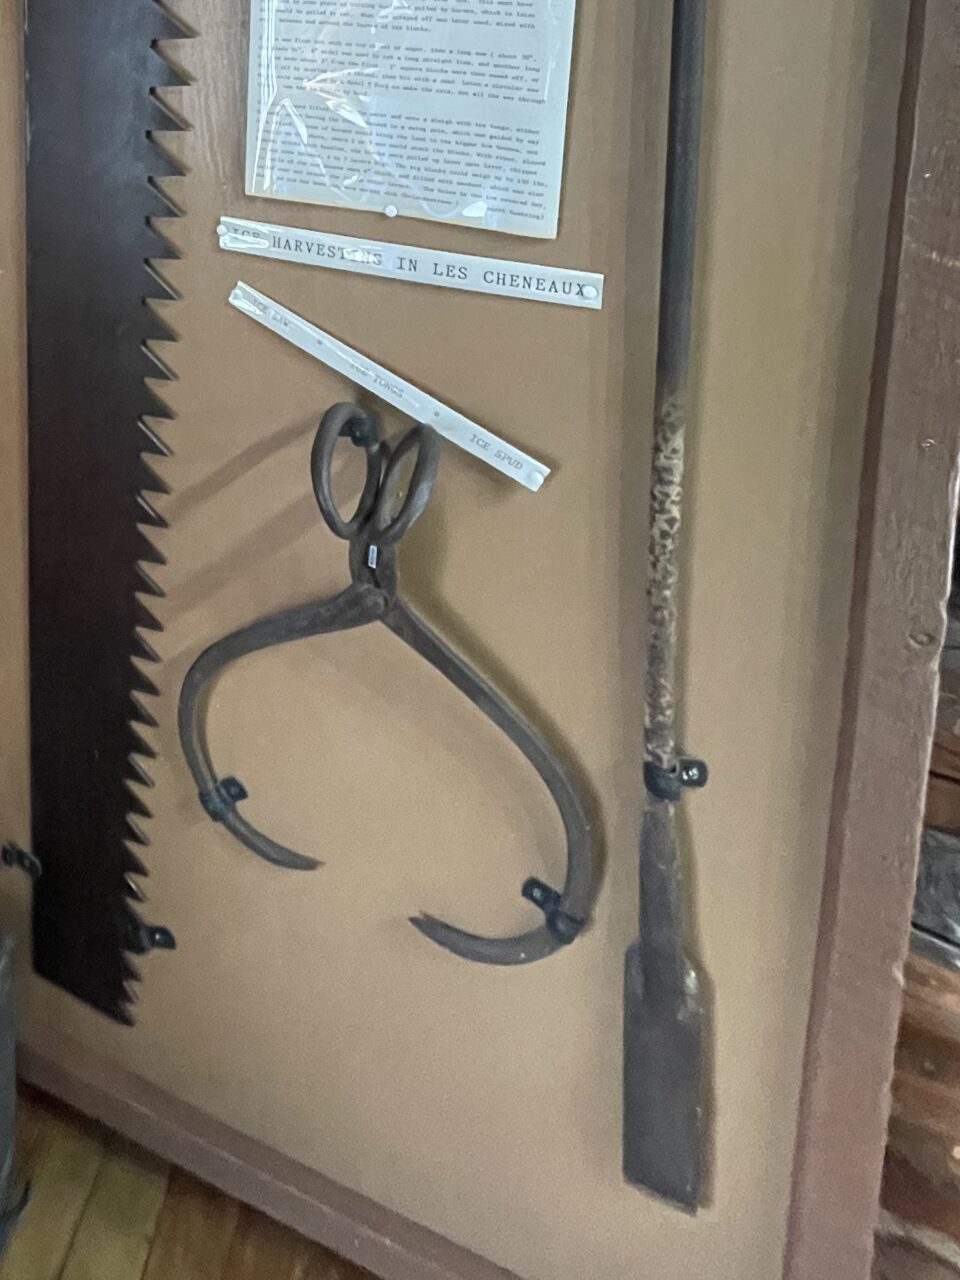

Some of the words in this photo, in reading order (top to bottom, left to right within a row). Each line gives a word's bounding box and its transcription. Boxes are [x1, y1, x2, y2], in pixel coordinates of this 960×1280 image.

[396, 256, 419, 273] IN
[432, 262, 469, 280] LES
[483, 270, 586, 297] CHENEAUX
[469, 433, 492, 451] ICE
[494, 449, 524, 470] SPUD
